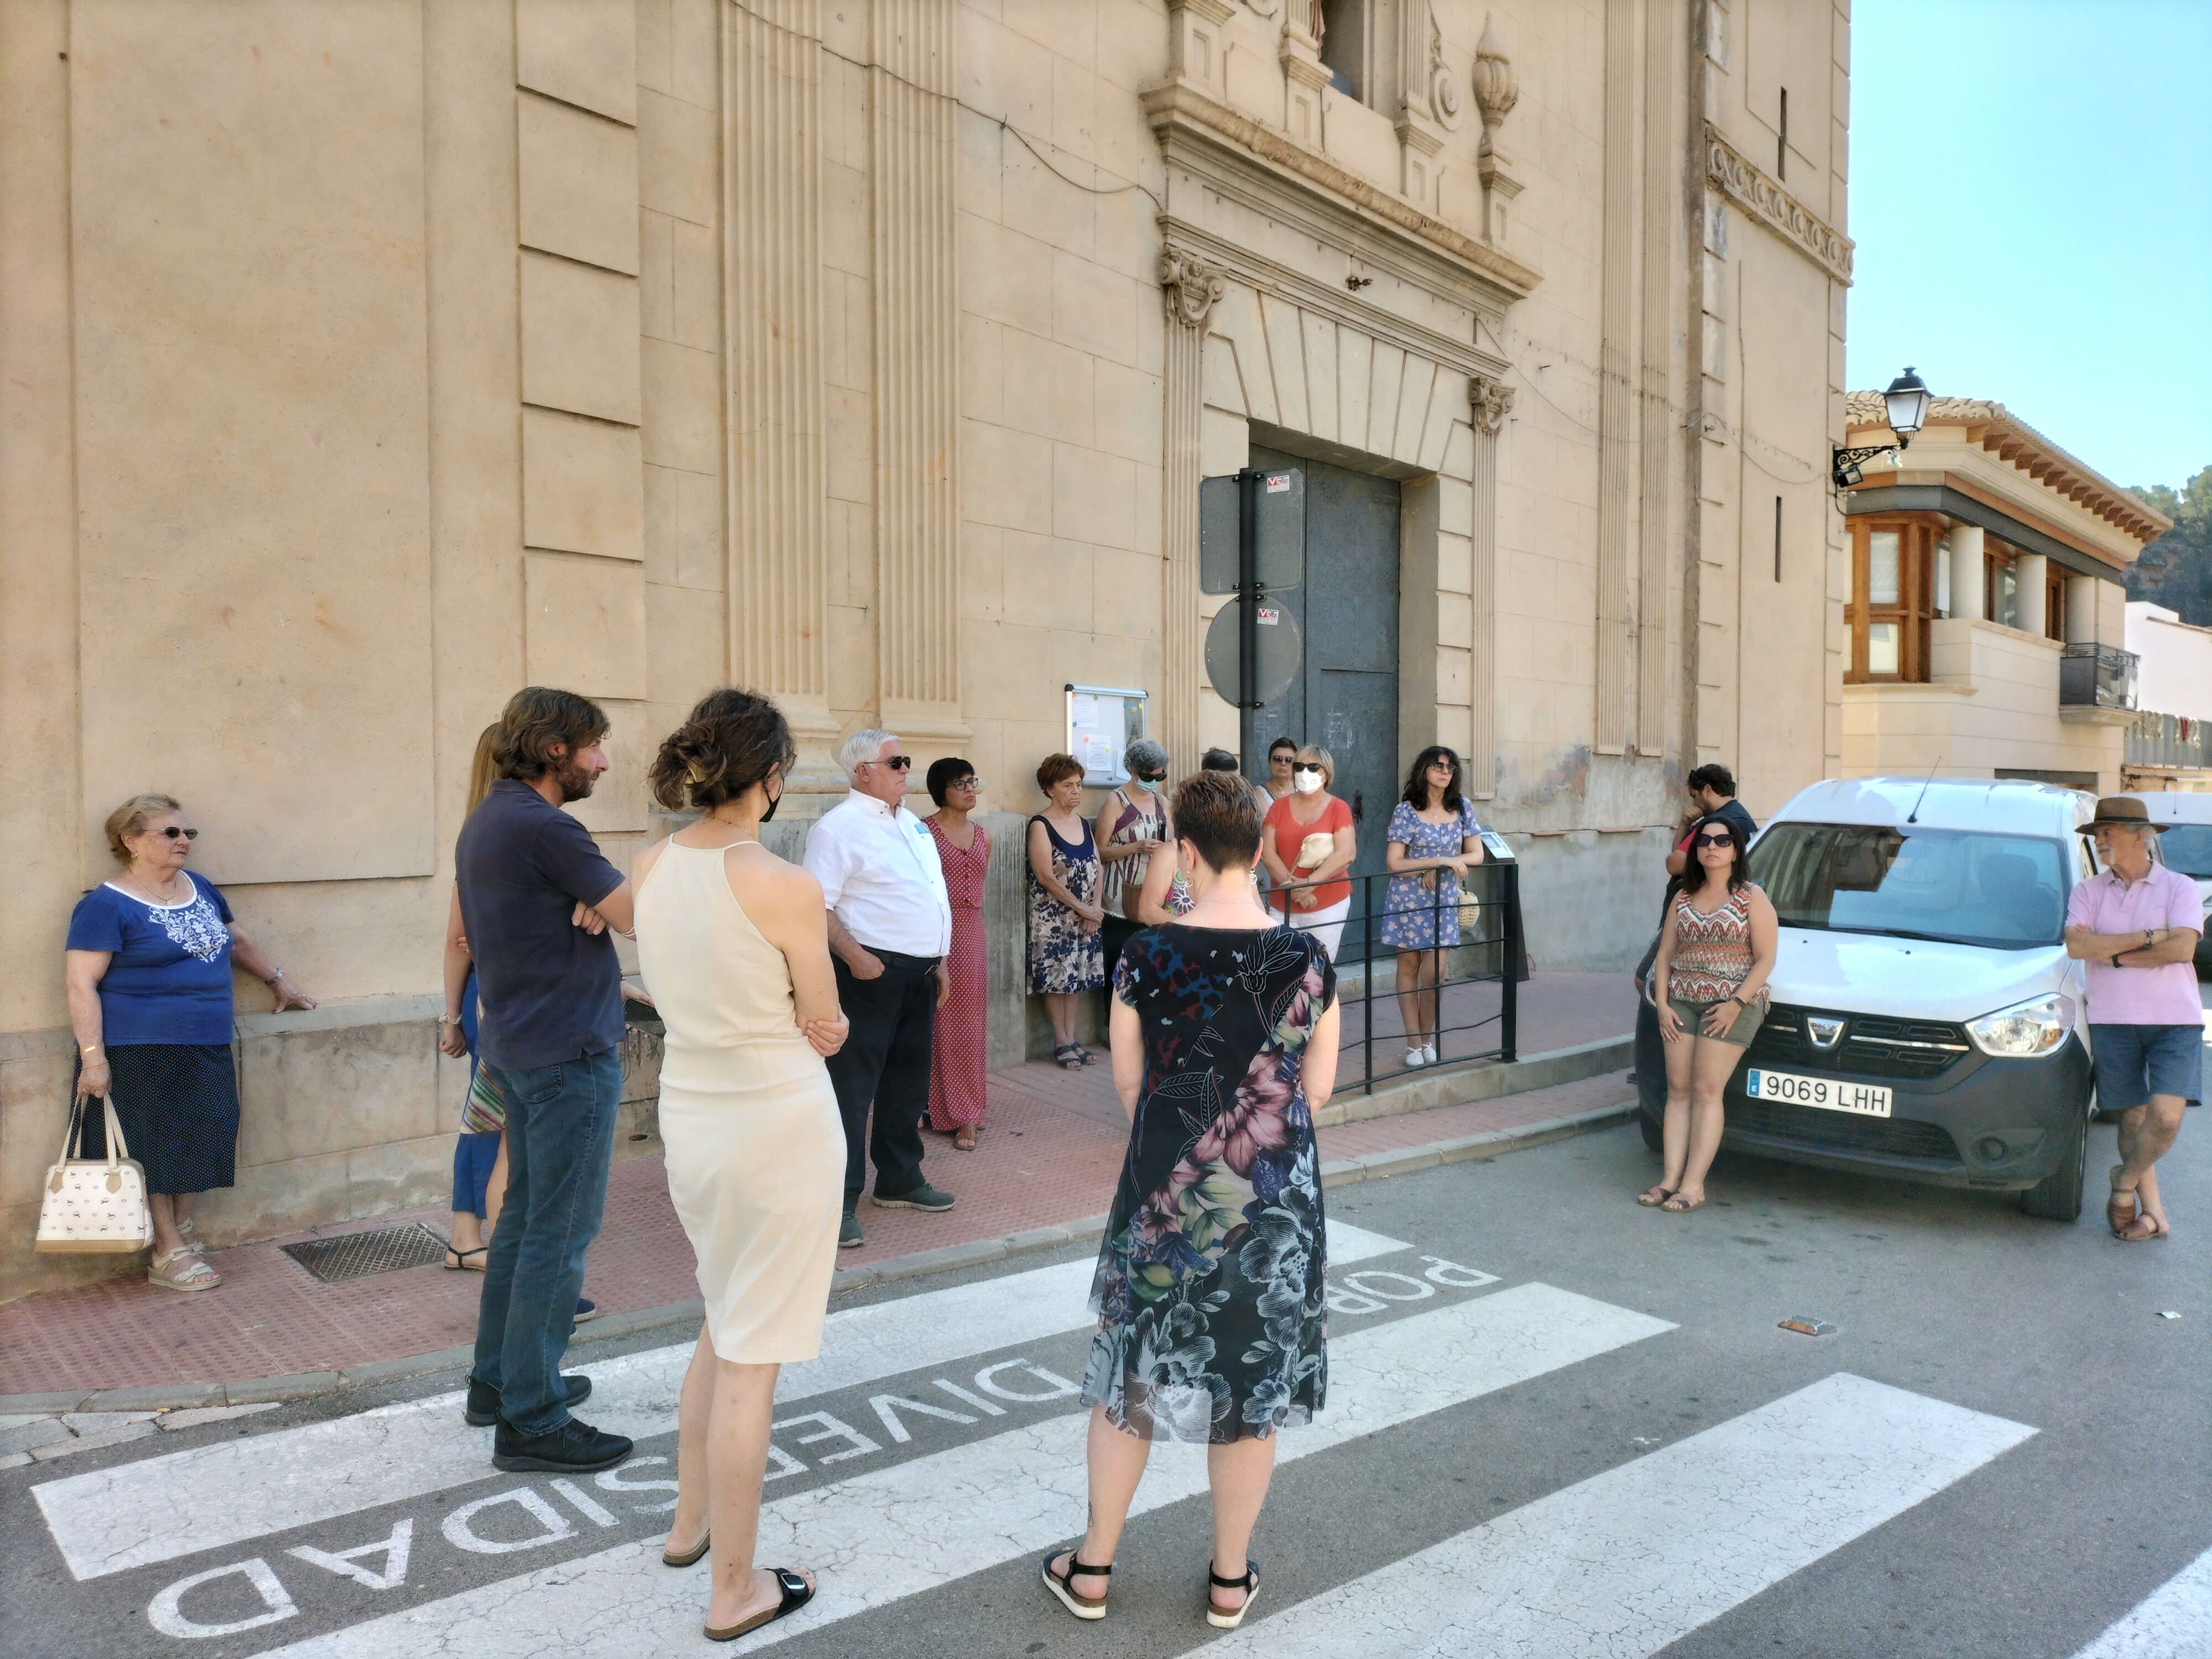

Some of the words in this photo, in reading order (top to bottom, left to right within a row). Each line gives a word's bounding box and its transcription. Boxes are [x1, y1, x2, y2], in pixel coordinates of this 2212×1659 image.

[1812, 1022, 1837, 1031] DACIA
[1767, 1076, 1827, 1103] 9069
[1838, 1086, 1885, 1112] LHH
